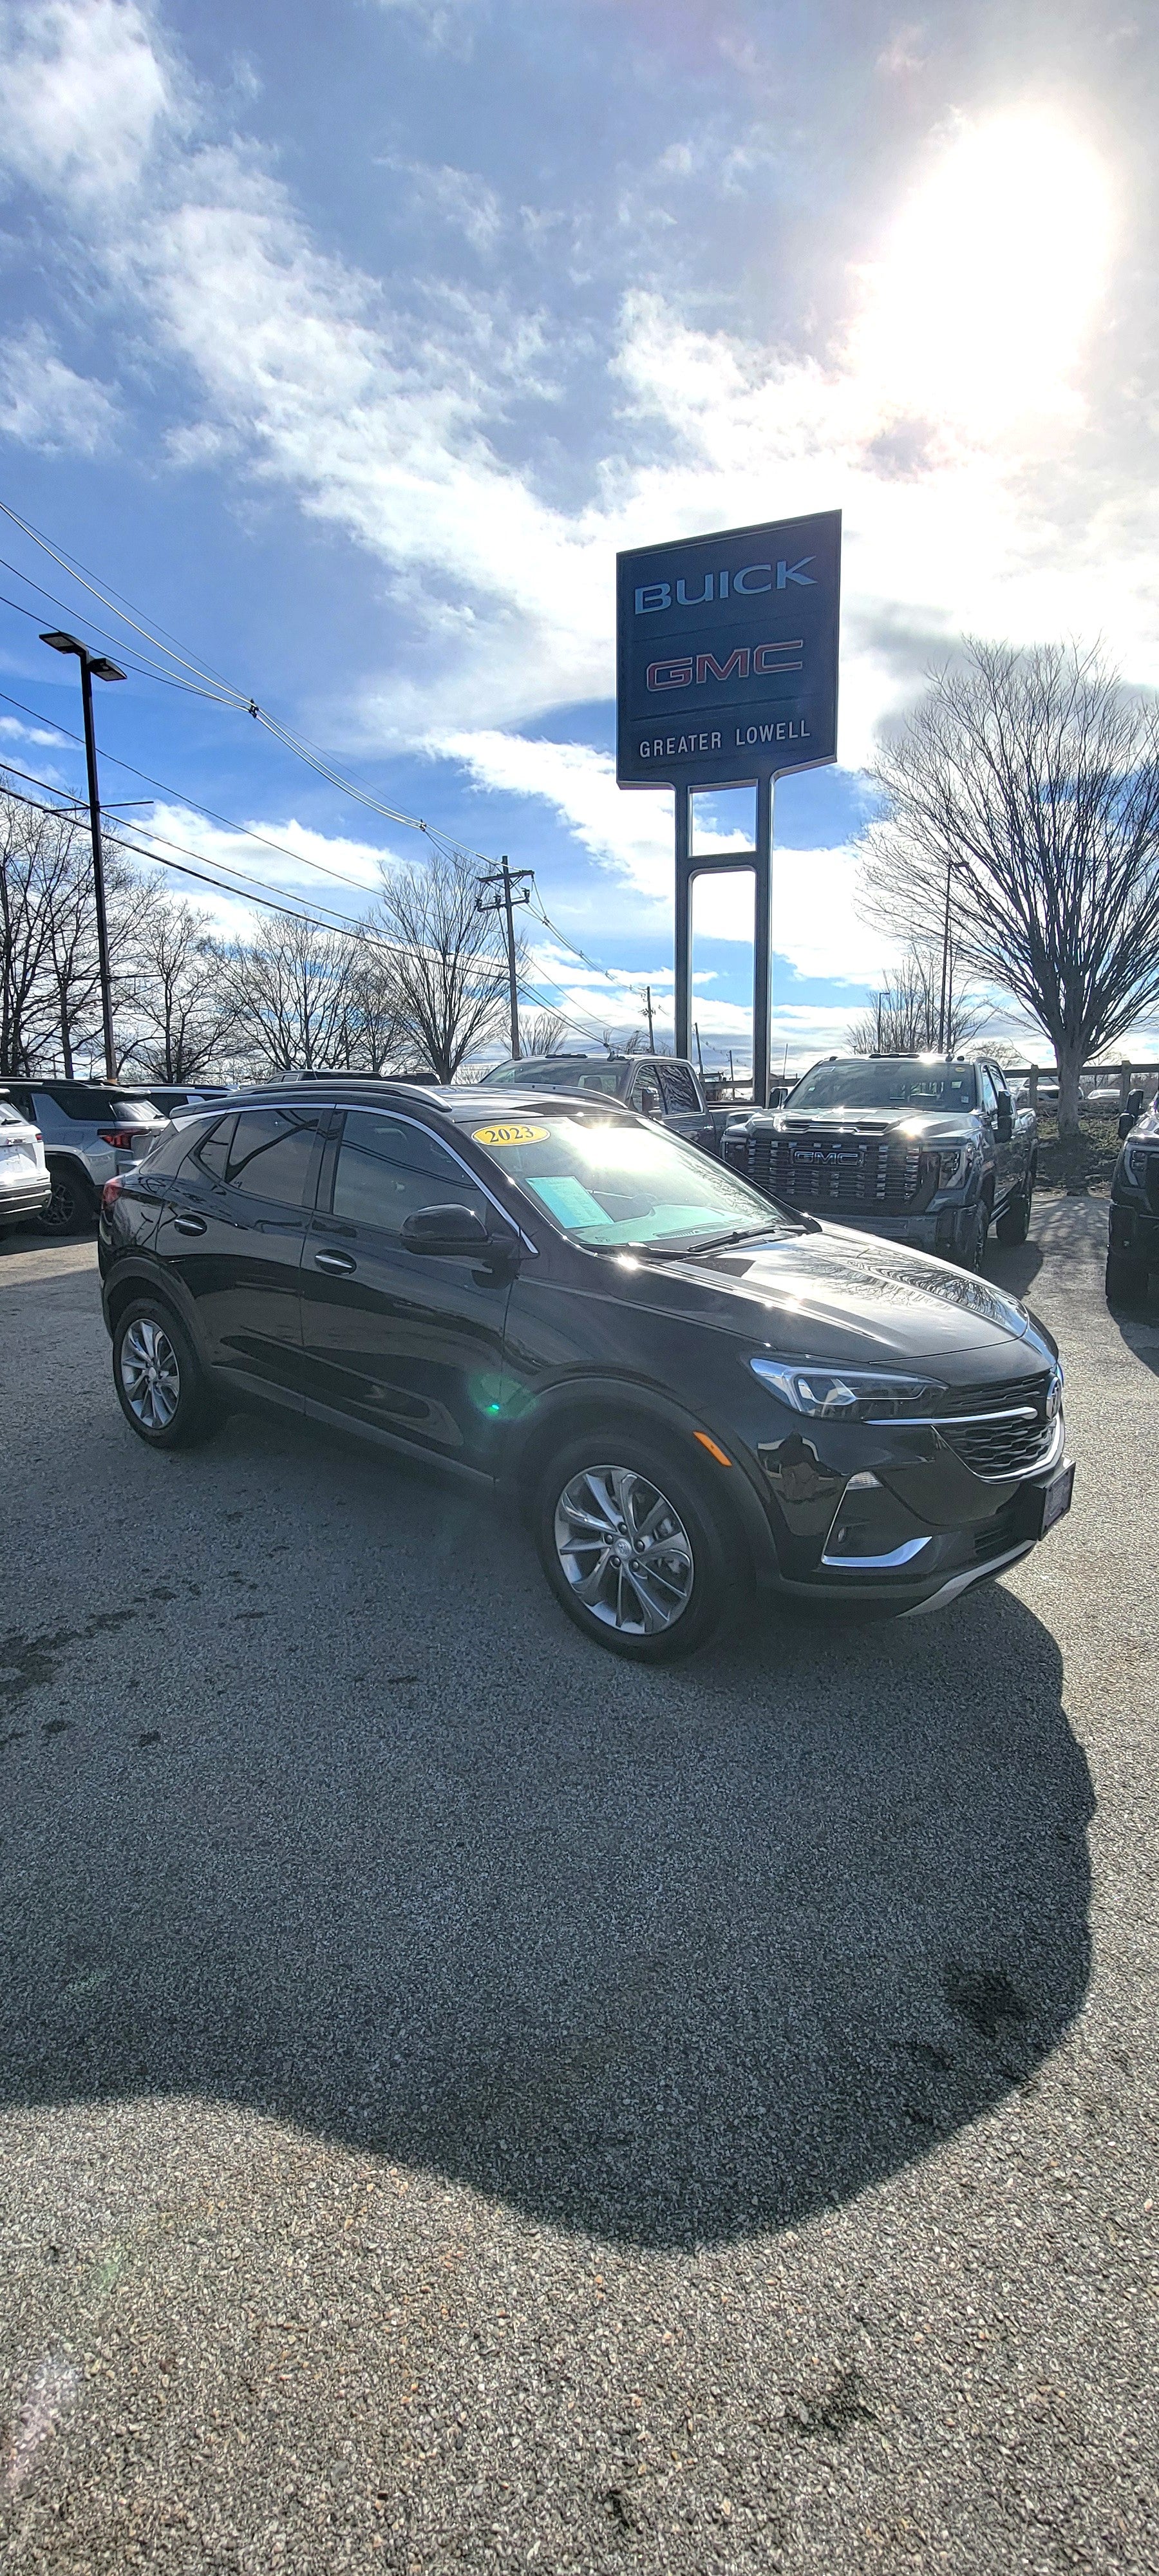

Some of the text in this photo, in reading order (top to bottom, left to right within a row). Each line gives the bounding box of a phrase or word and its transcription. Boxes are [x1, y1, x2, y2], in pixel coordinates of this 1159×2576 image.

[634, 556, 818, 615] BUICK
[646, 639, 804, 692] GMC
[639, 720, 811, 758] GREATER LOWELL
[485, 1126, 534, 1142] 2023
[794, 1151, 858, 1165] GMC
